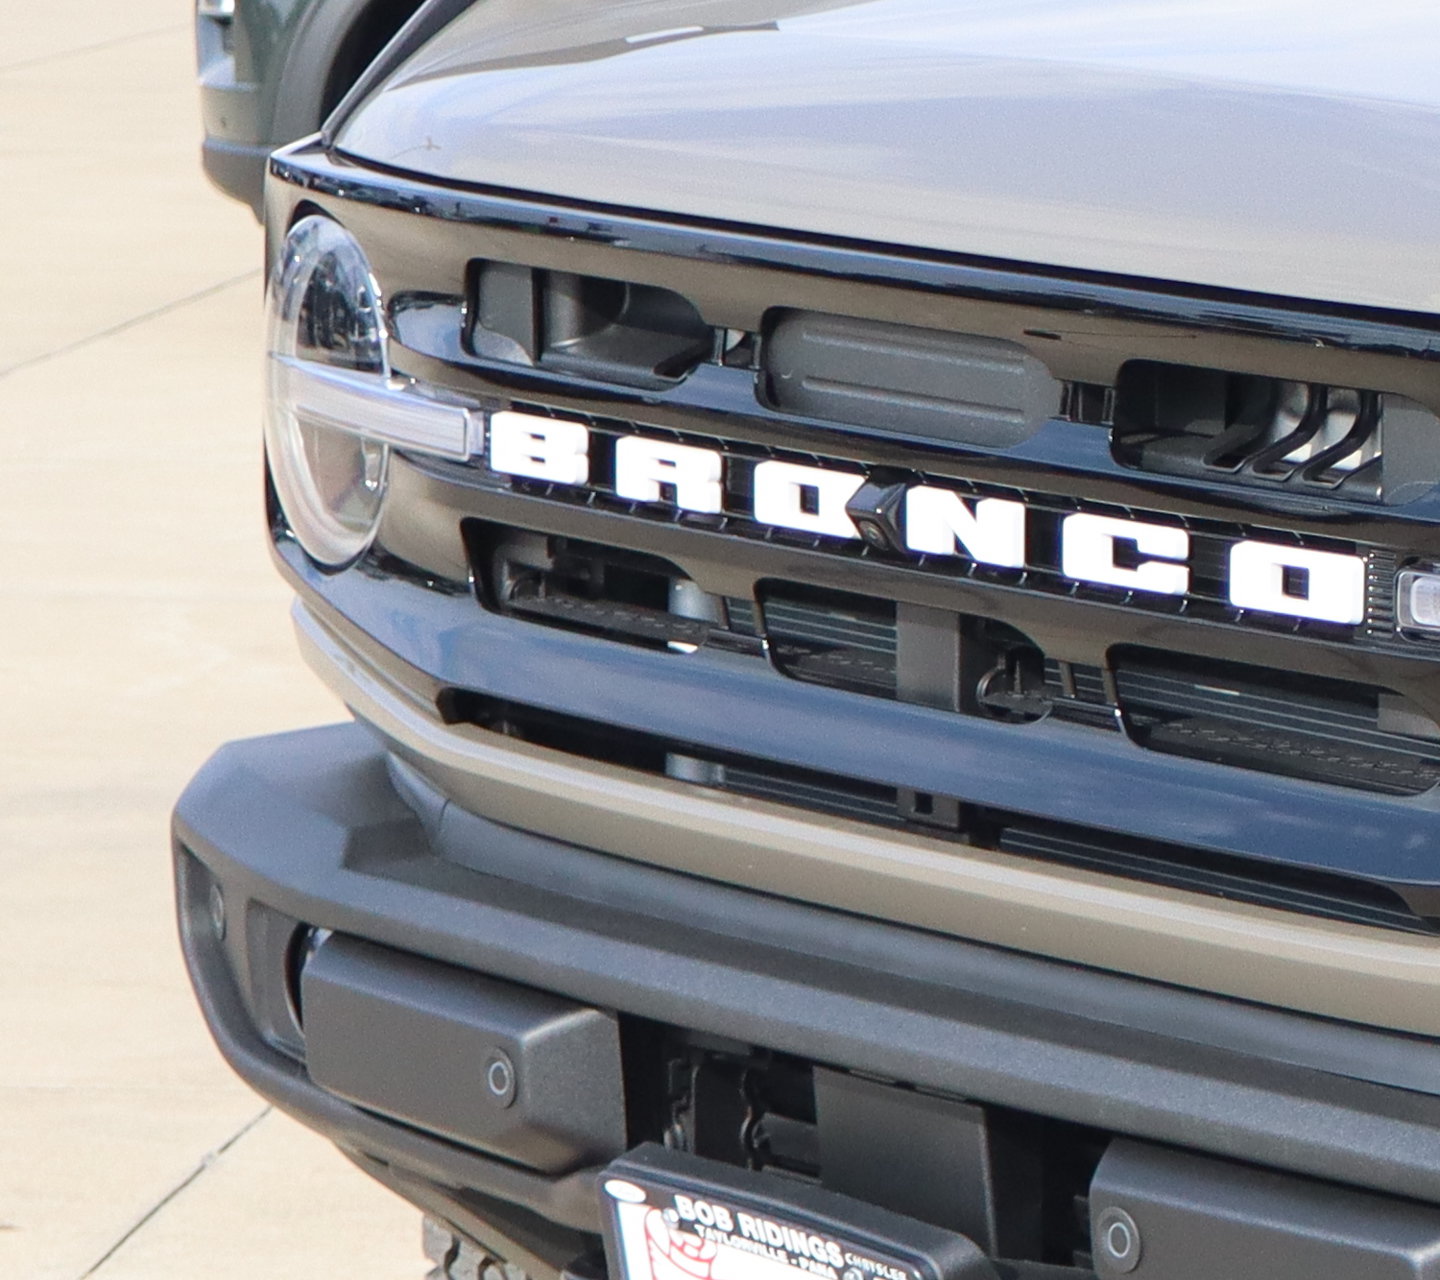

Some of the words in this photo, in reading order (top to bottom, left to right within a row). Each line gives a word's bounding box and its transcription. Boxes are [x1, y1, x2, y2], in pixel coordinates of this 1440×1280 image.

[489, 410, 1367, 625] BRONCO
[674, 1195, 735, 1232] BOB
[737, 1212, 845, 1269] RIDINGS
[694, 1223, 790, 1265] TAYLORVILLE
[799, 1254, 838, 1280] PANA
